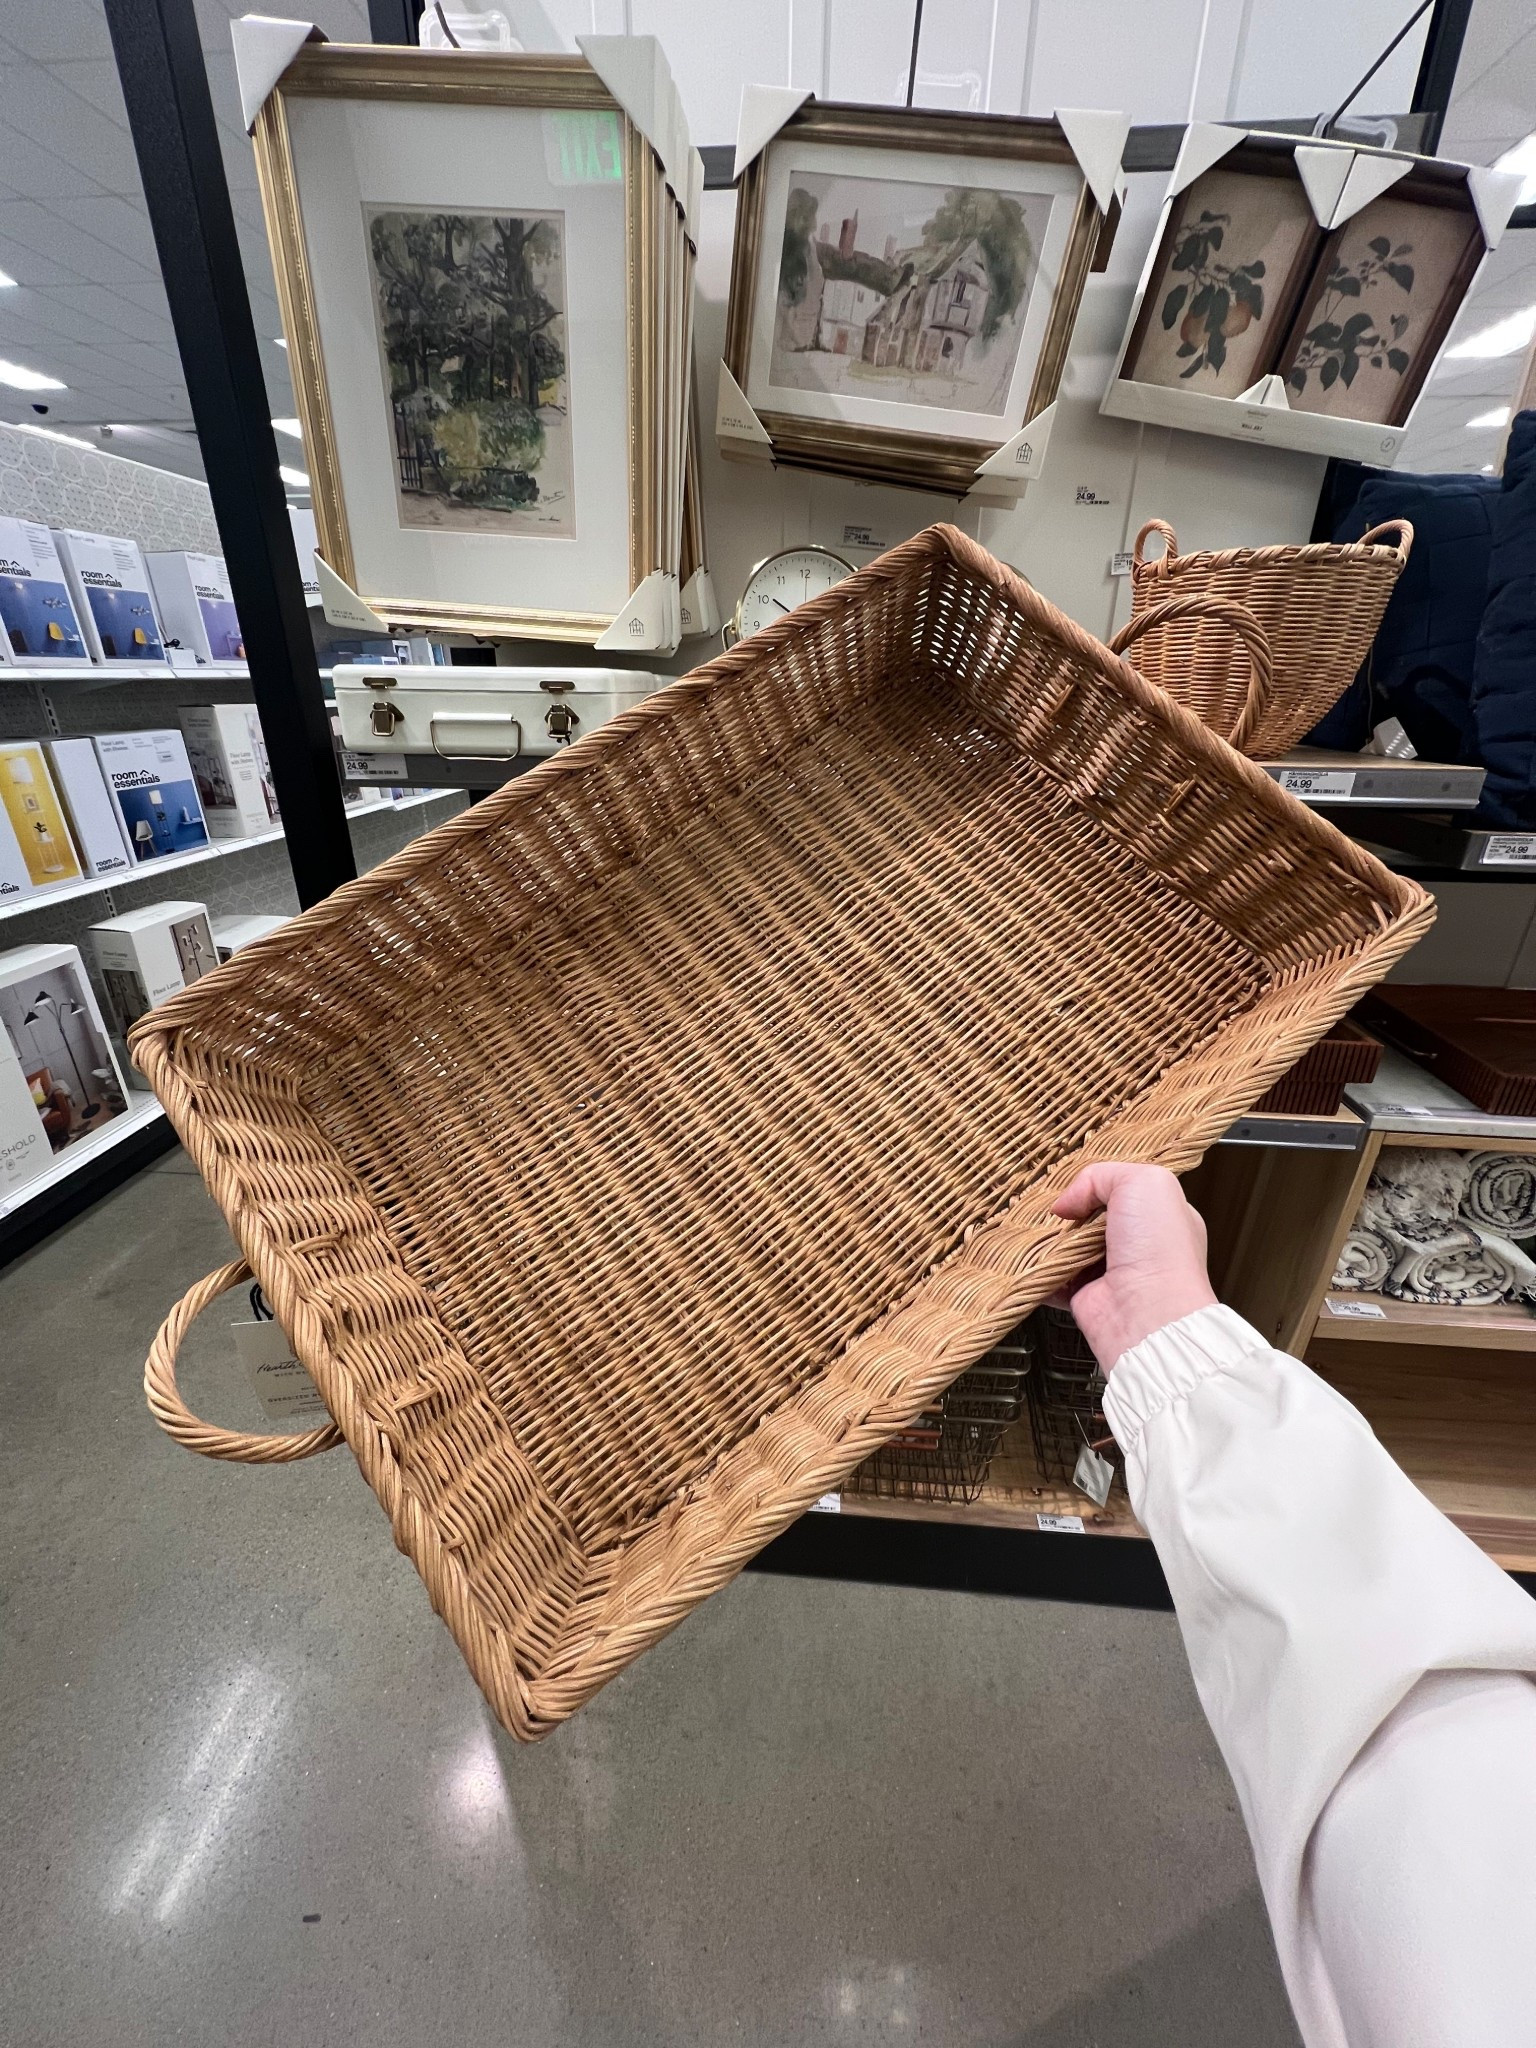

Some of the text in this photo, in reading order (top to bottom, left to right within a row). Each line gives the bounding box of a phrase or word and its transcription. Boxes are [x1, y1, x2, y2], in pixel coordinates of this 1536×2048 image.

[1076, 492, 1096, 500] 24.99
[80, 570, 104, 579] room
[799, 568, 811, 579] 12
[83, 577, 122, 588] essentials
[777, 575, 786, 585] 11
[827, 576, 832, 586] 1
[195, 585, 211, 593] room
[196, 591, 225, 600] essentials
[757, 595, 770, 605] 10
[753, 620, 760, 630] 9
[346, 762, 368, 770] 24.99
[111, 769, 138, 782] room
[114, 774, 160, 789] essentials
[1285, 779, 1312, 788] 24.99
[1505, 845, 1529, 854] 24.99
[96, 858, 113, 867] room
[97, 860, 127, 873] essentials
